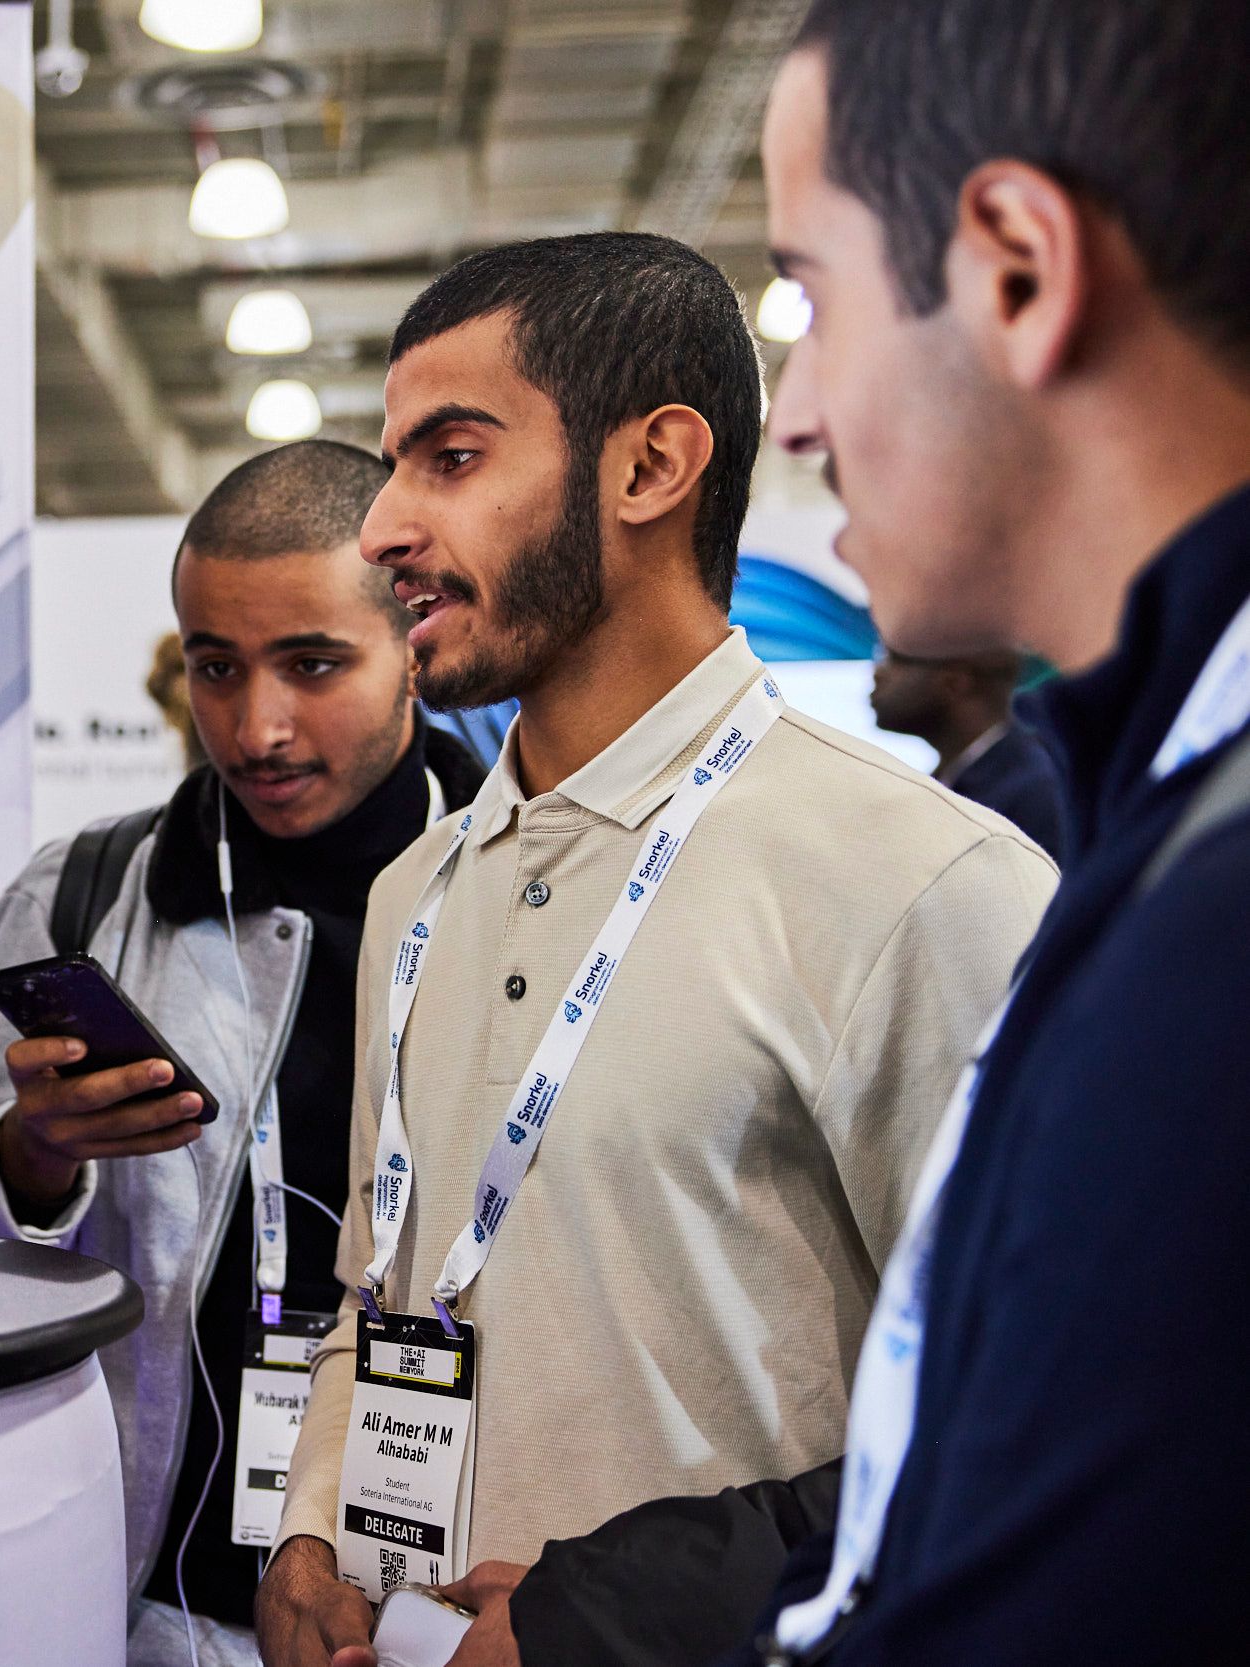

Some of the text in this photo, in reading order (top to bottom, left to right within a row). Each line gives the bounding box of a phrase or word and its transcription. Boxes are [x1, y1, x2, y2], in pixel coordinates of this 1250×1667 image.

[707, 726, 742, 768] Snorkel
[639, 830, 670, 879] Snorkel
[406, 943, 423, 985] Snorkel
[575, 951, 608, 1001] Snorkel
[517, 1072, 547, 1122] Snorkel
[387, 1176, 402, 1221] Snorkel
[479, 1184, 498, 1226] Snorkel
[362, 1412, 453, 1446] Ali Amer M M
[377, 1440, 429, 1464] Alhababi
[360, 1486, 433, 1512] Soteria International AG
[385, 1477, 410, 1491] Student
[365, 1515, 423, 1545] DELEGATE
